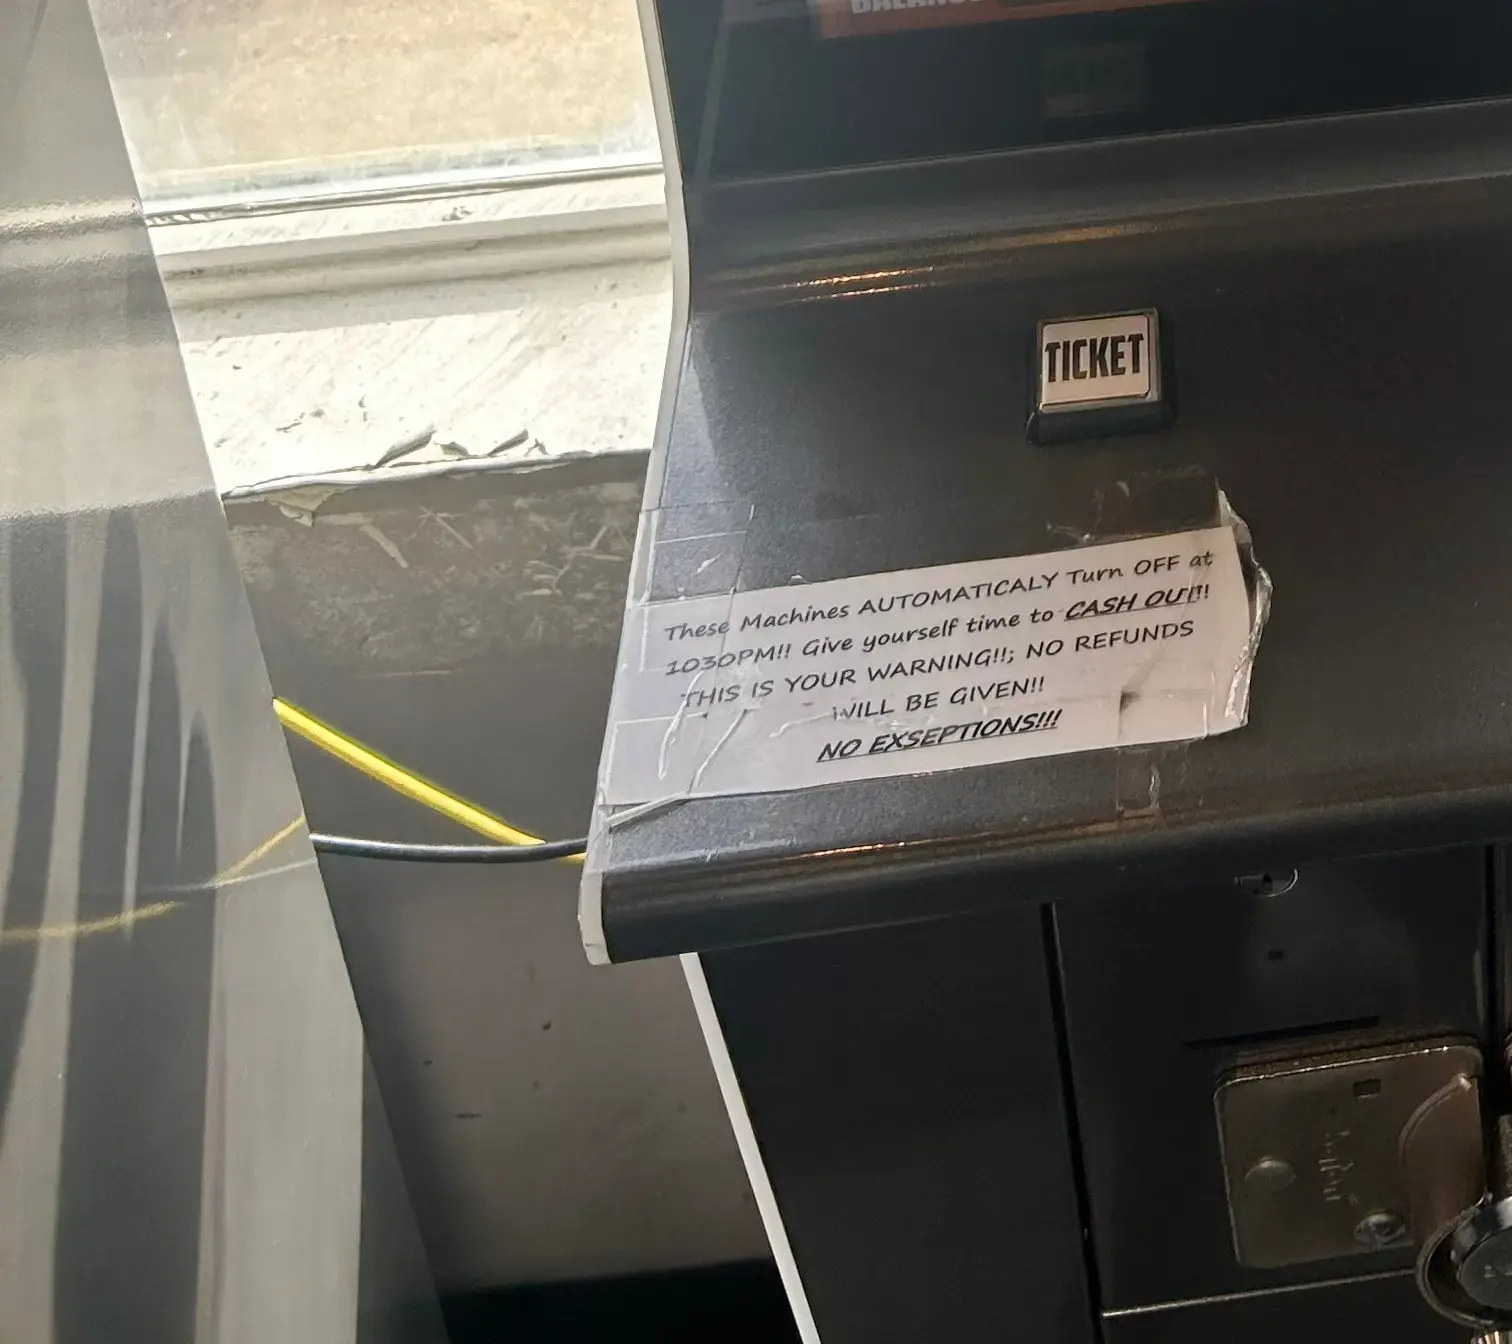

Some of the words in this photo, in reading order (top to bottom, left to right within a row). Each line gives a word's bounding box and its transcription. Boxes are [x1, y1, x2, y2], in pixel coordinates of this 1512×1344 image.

[1045, 332, 1144, 382] TICKET
[665, 619, 730, 642] These
[741, 603, 850, 632] Machines
[858, 572, 1060, 614] AUTOMATICALY
[1066, 567, 1124, 585] Turn
[1134, 555, 1181, 575] OFF
[1189, 551, 1214, 568] at
[665, 643, 791, 676] 1030PM!!
[802, 635, 853, 657] Give
[862, 618, 958, 653] yourself
[966, 612, 1021, 635] time
[1030, 608, 1054, 625] to
[1065, 593, 1139, 620] CASH
[681, 682, 739, 708] THIS
[751, 679, 775, 698] IS
[785, 668, 856, 694] YOUR
[1026, 638, 1065, 659] NO
[1075, 620, 1194, 652] REFUNDS
[832, 699, 894, 721] WILL
[905, 691, 939, 713] BE
[950, 676, 1046, 706] GIVEN!!
[817, 738, 861, 762] NO
[868, 708, 1063, 758] EXSEPTIONS!!!
